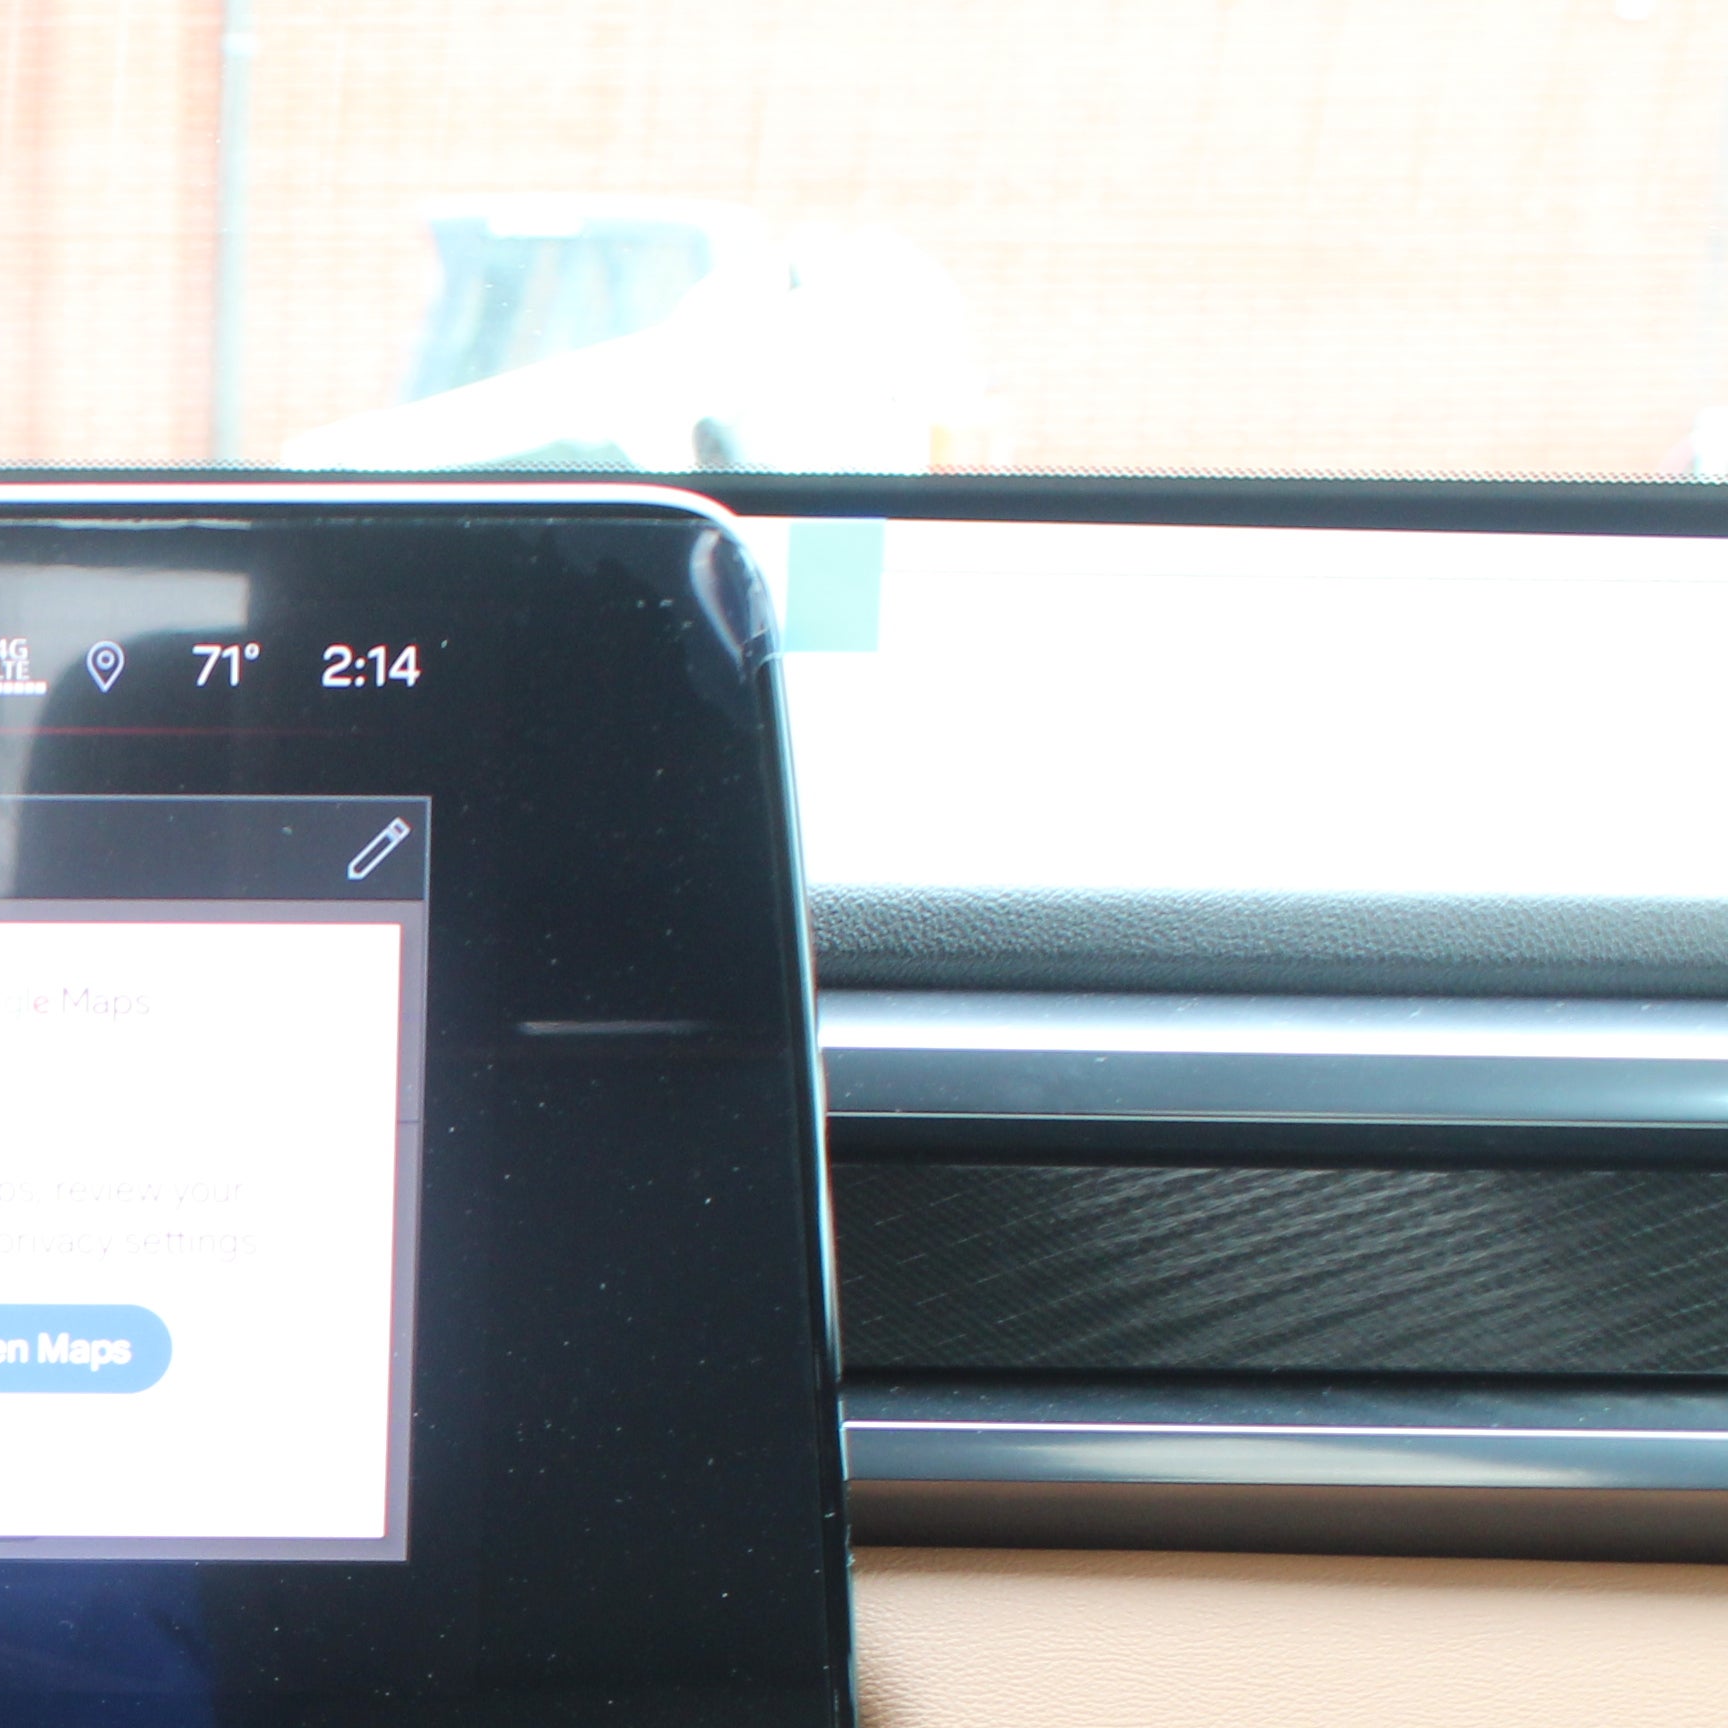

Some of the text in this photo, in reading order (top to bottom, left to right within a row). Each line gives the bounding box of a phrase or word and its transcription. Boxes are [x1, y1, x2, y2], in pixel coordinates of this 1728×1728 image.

[321, 643, 422, 688] 2:14
[60, 986, 151, 1021] Maps
[37, 1332, 132, 1372] Maps
